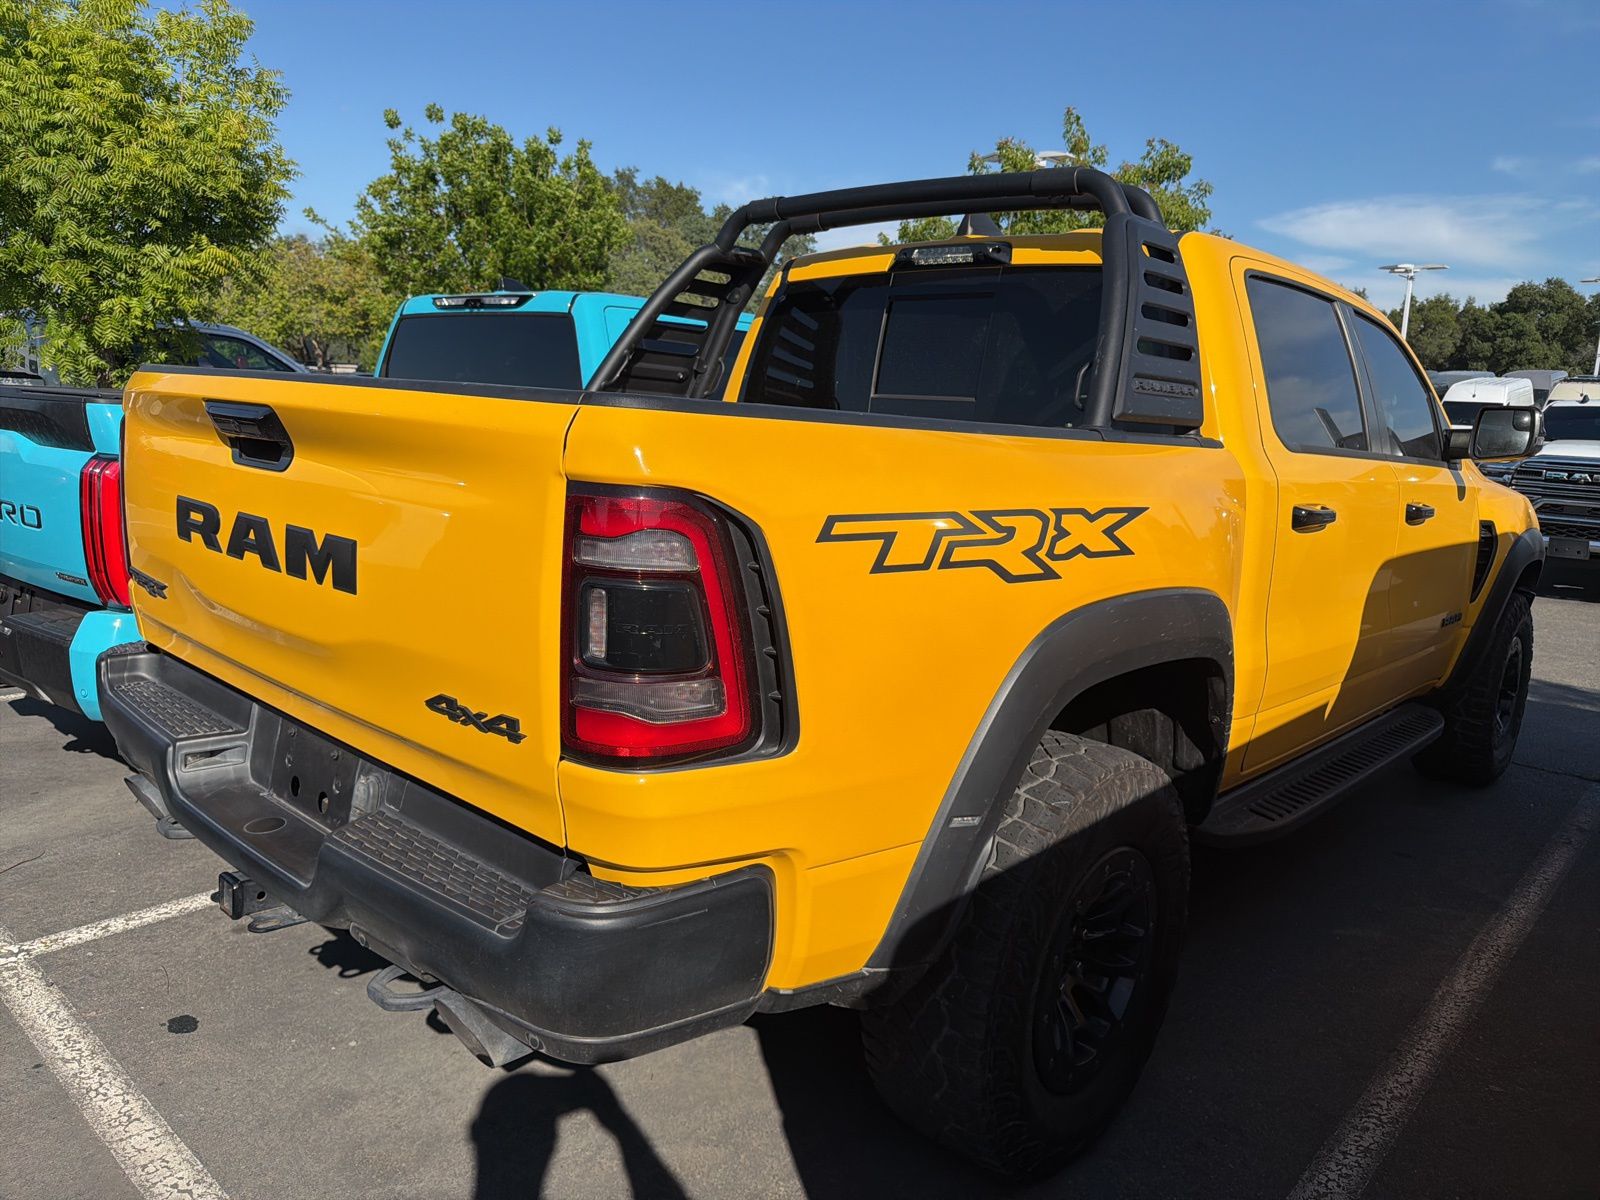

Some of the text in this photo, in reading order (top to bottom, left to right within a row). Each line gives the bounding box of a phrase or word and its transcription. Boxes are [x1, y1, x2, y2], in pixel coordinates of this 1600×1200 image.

[0, 500, 43, 530] RO
[176, 495, 358, 596] RAM
[815, 506, 1151, 583] TRX
